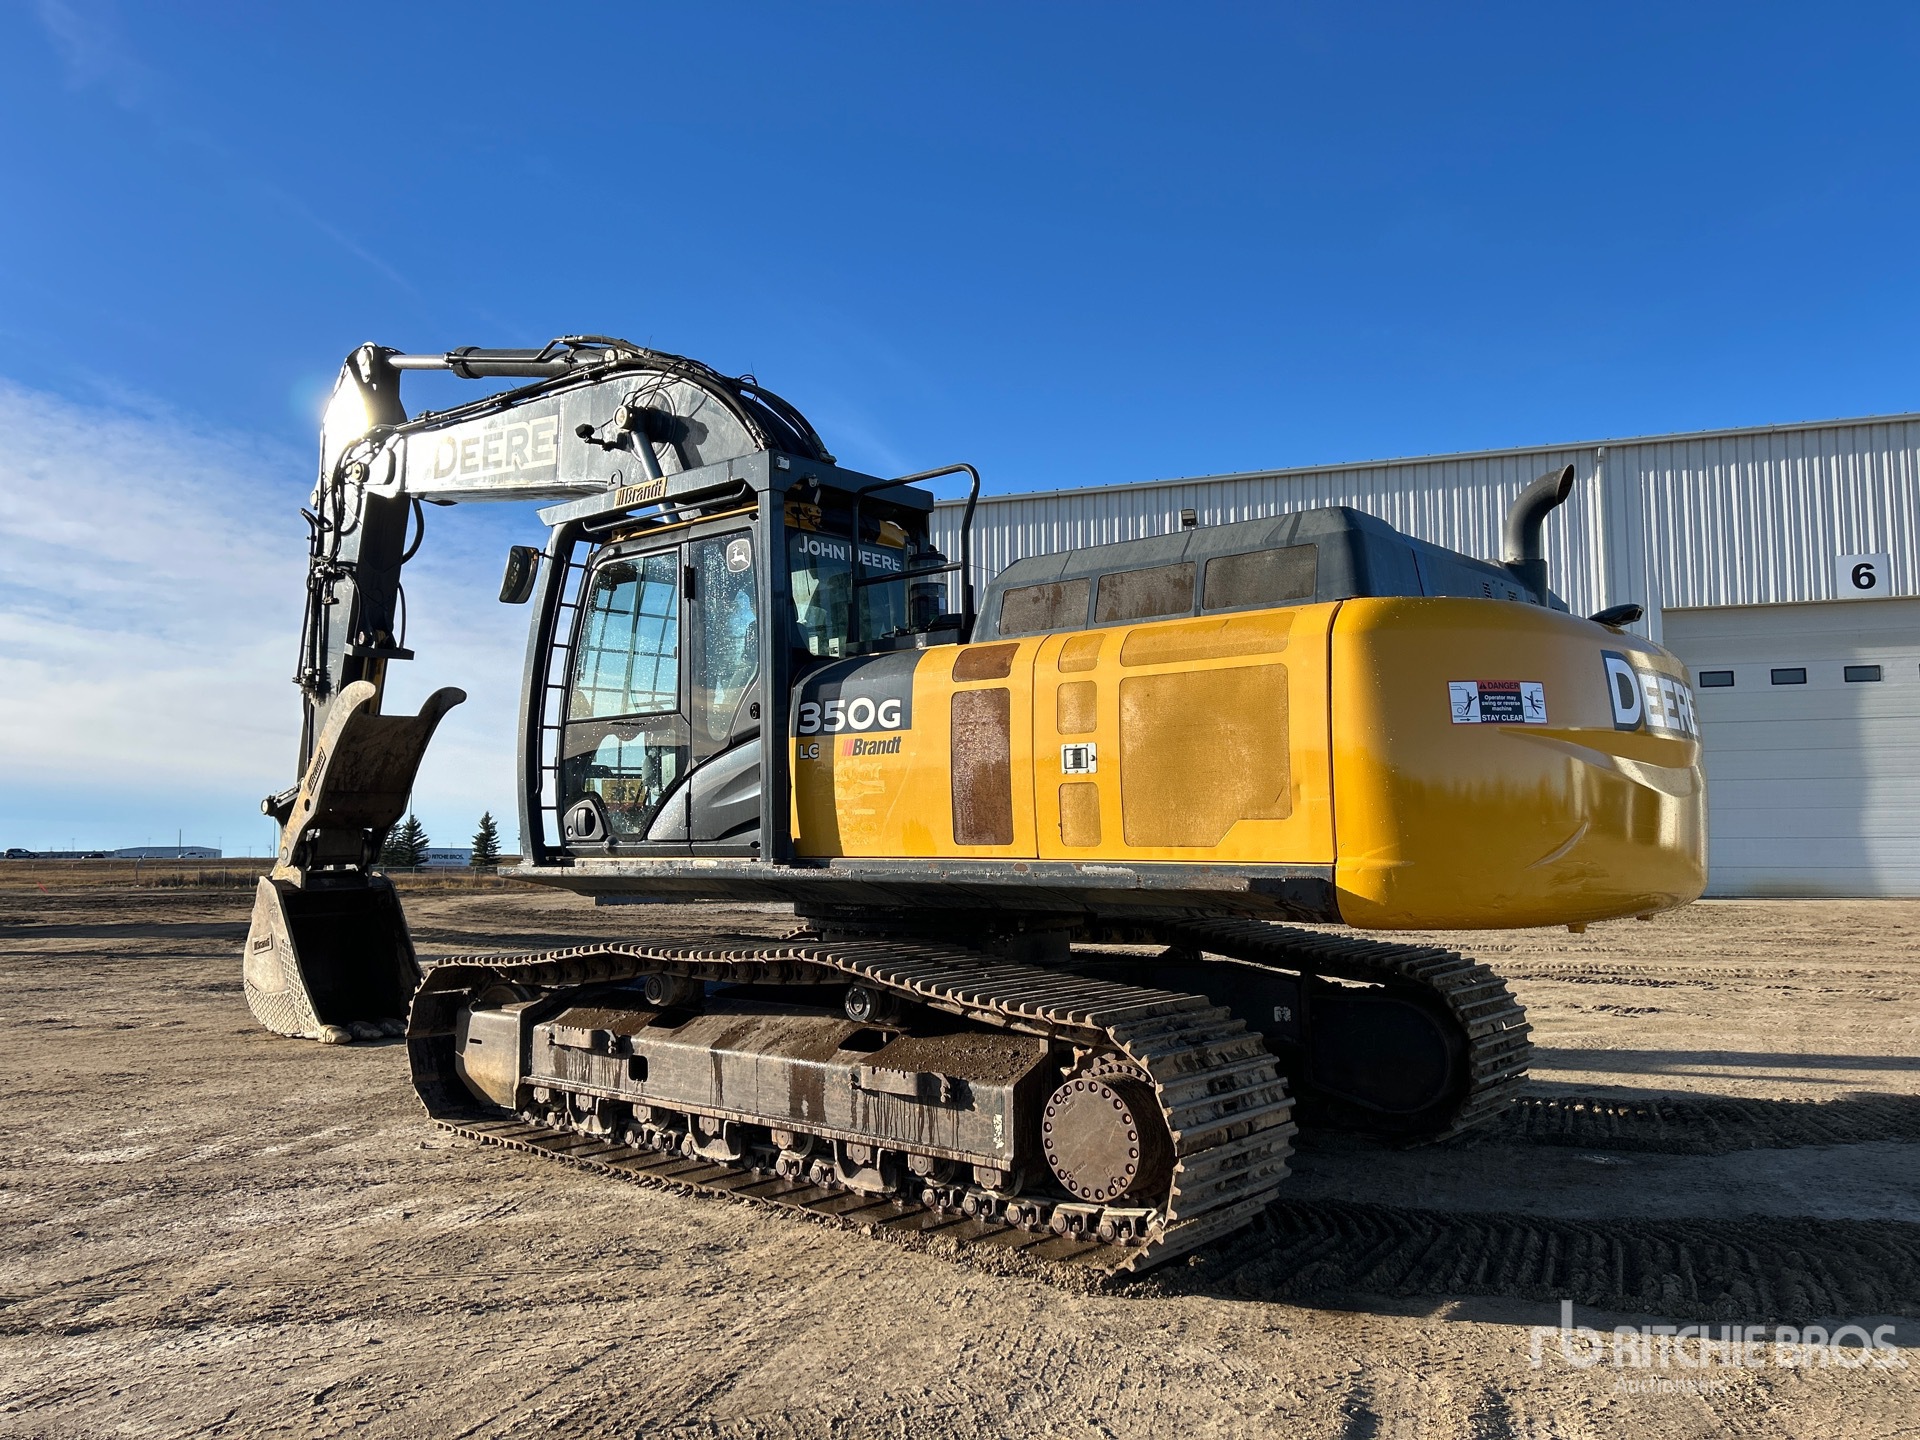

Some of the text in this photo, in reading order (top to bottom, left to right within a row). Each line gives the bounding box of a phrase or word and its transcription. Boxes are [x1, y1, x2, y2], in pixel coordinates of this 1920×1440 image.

[433, 418, 557, 479] DEERE
[624, 481, 663, 504] Brandt
[799, 536, 845, 560] JOHN
[1852, 563, 1876, 589] 6
[1488, 682, 1519, 690] DANGER
[1605, 657, 1700, 737] DEERE
[1481, 700, 1496, 708] swing
[1484, 694, 1505, 702] Operator
[799, 697, 901, 733] 350G
[799, 744, 819, 759] LC
[852, 736, 901, 756] Brandt
